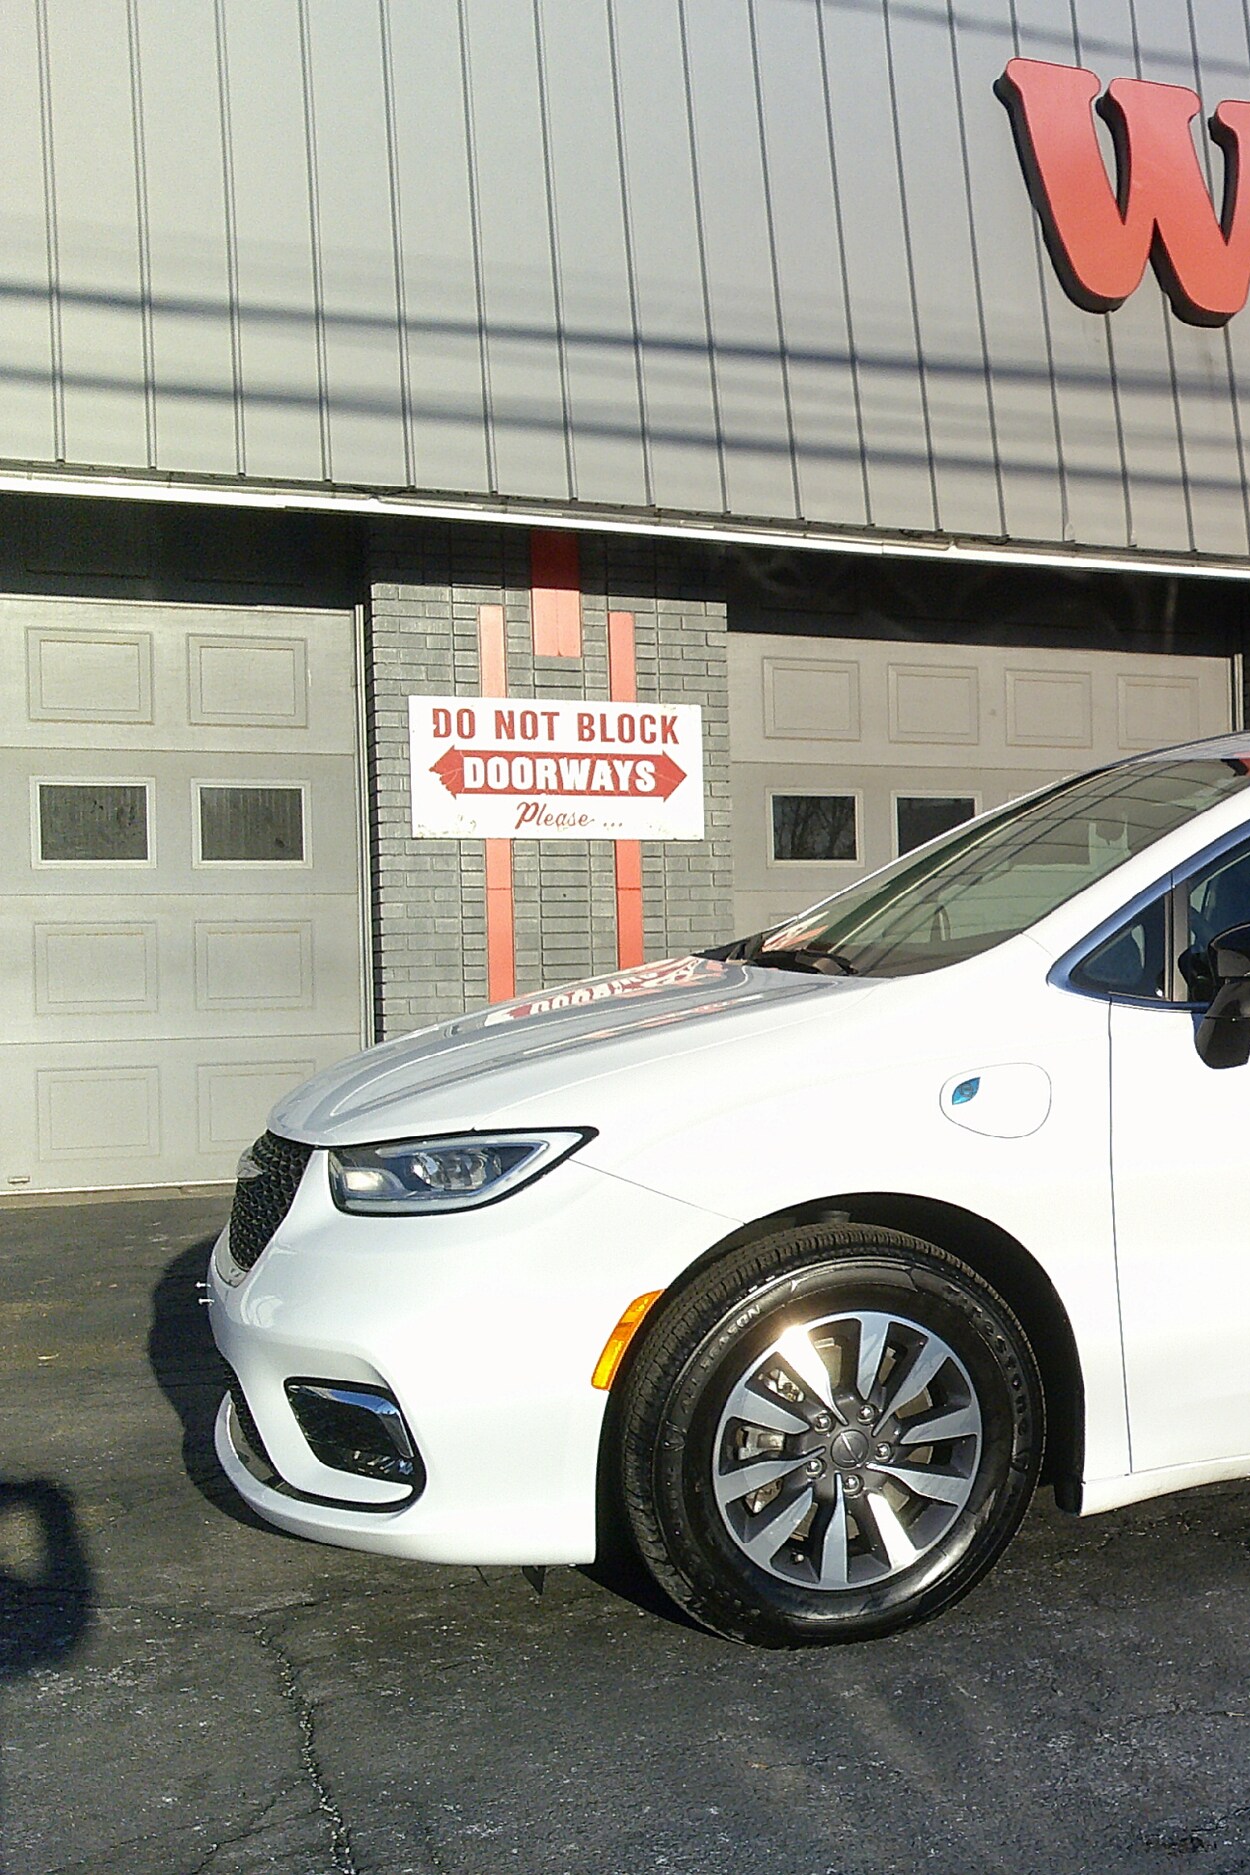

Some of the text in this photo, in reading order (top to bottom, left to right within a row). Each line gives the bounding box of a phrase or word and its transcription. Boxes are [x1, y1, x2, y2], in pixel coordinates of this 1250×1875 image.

[432, 707, 680, 745] DO NOT BLOCK
[463, 755, 656, 792] DOORWAYS
[514, 801, 596, 830] Please
